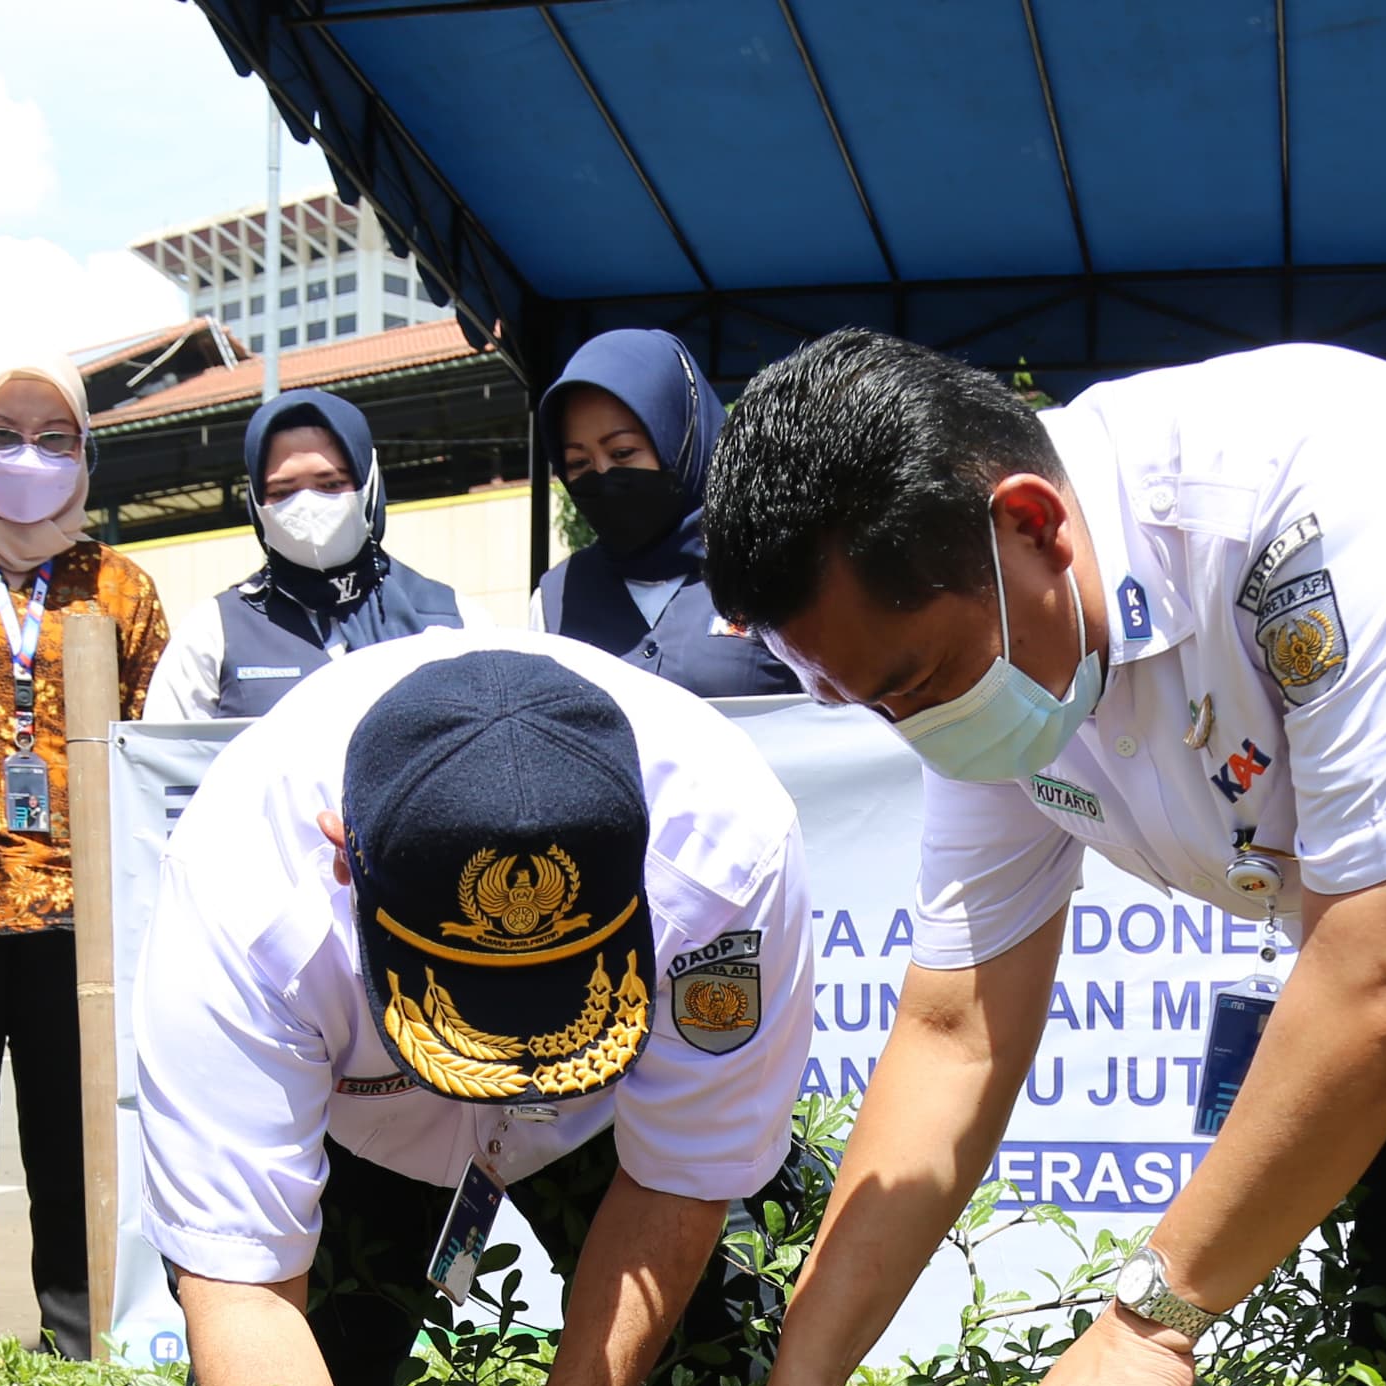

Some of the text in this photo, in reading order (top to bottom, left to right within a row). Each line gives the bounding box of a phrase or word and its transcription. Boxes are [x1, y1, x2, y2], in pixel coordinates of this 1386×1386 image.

[1245, 540, 1287, 603] DAOP
[1211, 738, 1272, 804] KAI
[1059, 903, 1300, 954] DONE
[673, 938, 734, 973] DAOP
[730, 966, 753, 976] API
[983, 1151, 1193, 1204] ERASI
